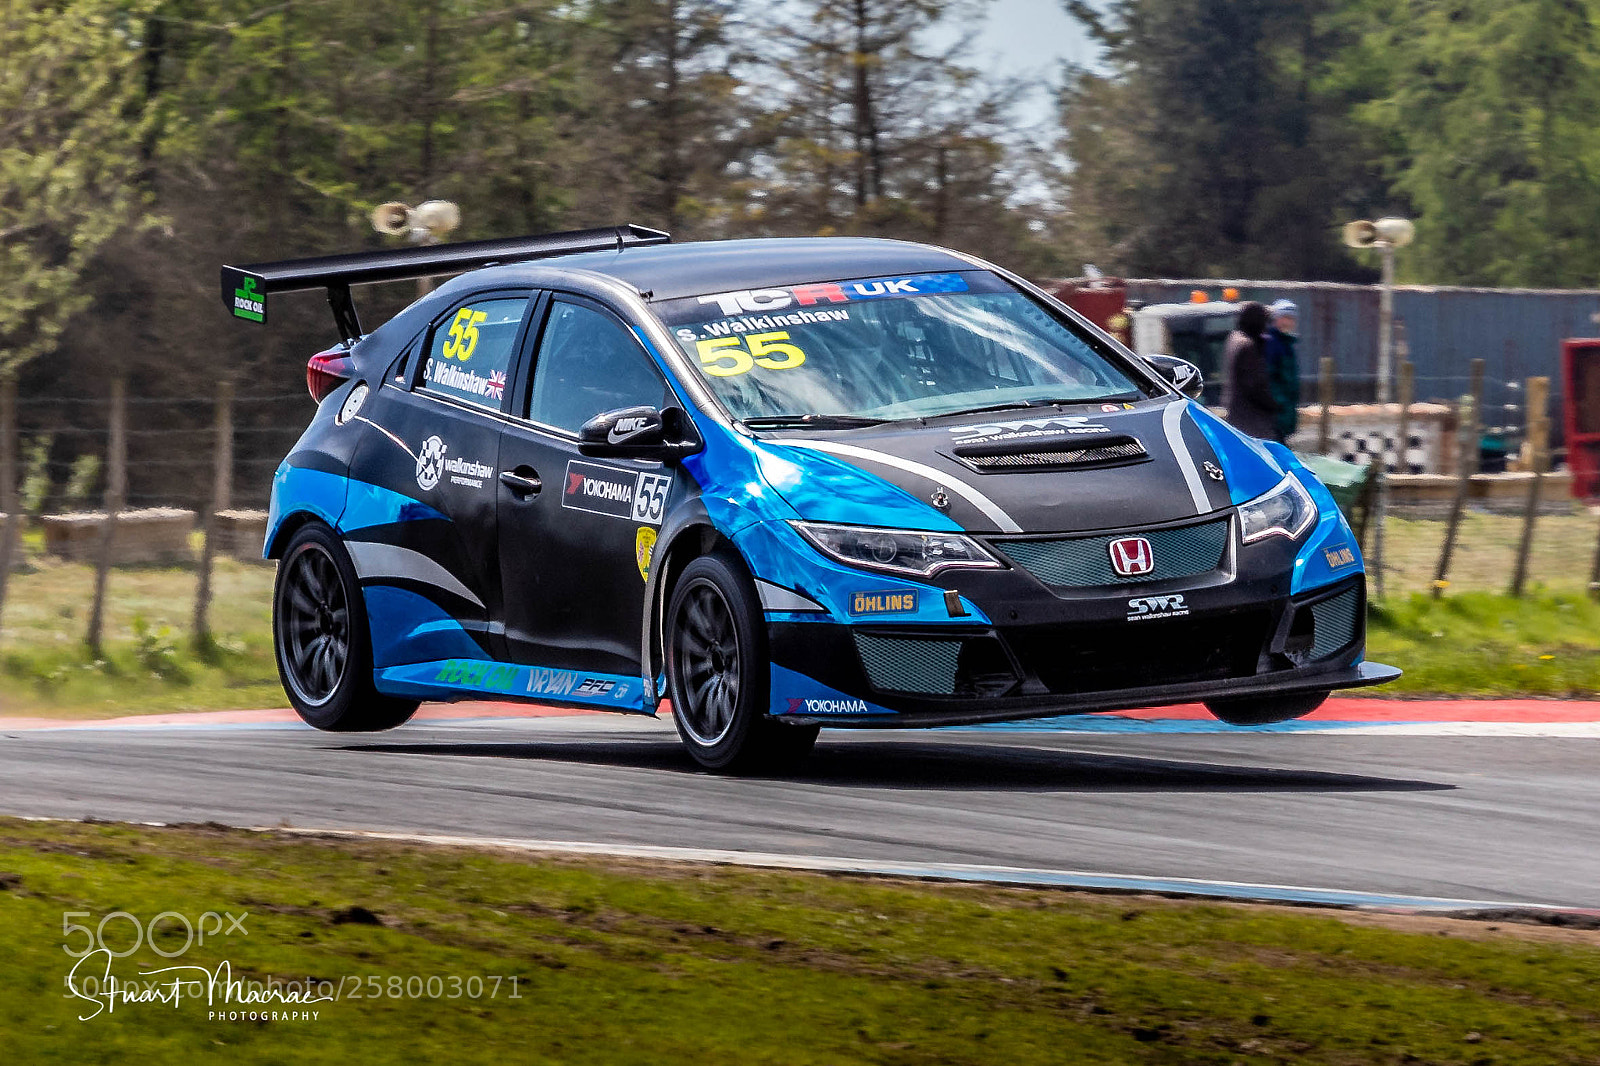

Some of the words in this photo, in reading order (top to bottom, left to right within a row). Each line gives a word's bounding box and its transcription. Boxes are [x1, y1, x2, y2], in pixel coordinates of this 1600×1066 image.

[234, 296, 253, 311] ROCK
[253, 301, 264, 314] OIL
[698, 281, 849, 317] TCR
[853, 279, 920, 297] UK
[443, 307, 488, 362] 55
[695, 330, 807, 377] 55
[433, 360, 489, 396] Walkinshaw
[614, 417, 648, 432] NIKE
[583, 477, 633, 503] YOKOHAMA
[637, 475, 669, 521] 55
[805, 699, 868, 712] YOKOHAMA
